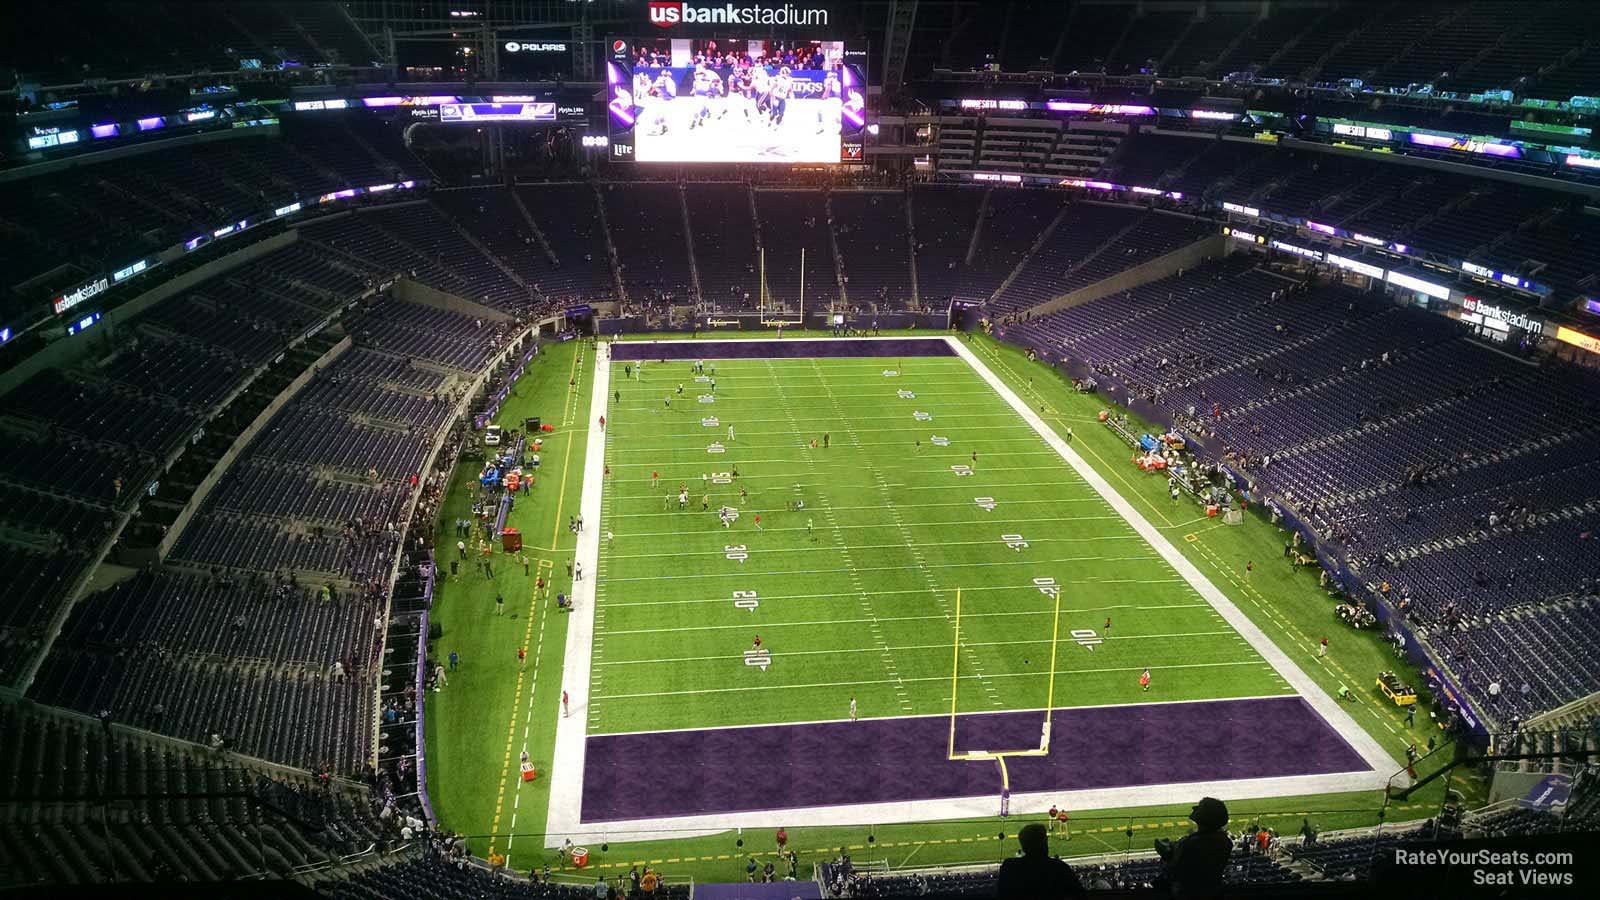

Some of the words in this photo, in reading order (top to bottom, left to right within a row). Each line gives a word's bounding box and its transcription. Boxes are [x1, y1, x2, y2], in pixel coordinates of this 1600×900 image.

[1001, 534, 1029, 549] 30
[732, 590, 759, 608] 20
[1071, 629, 1104, 645] 10
